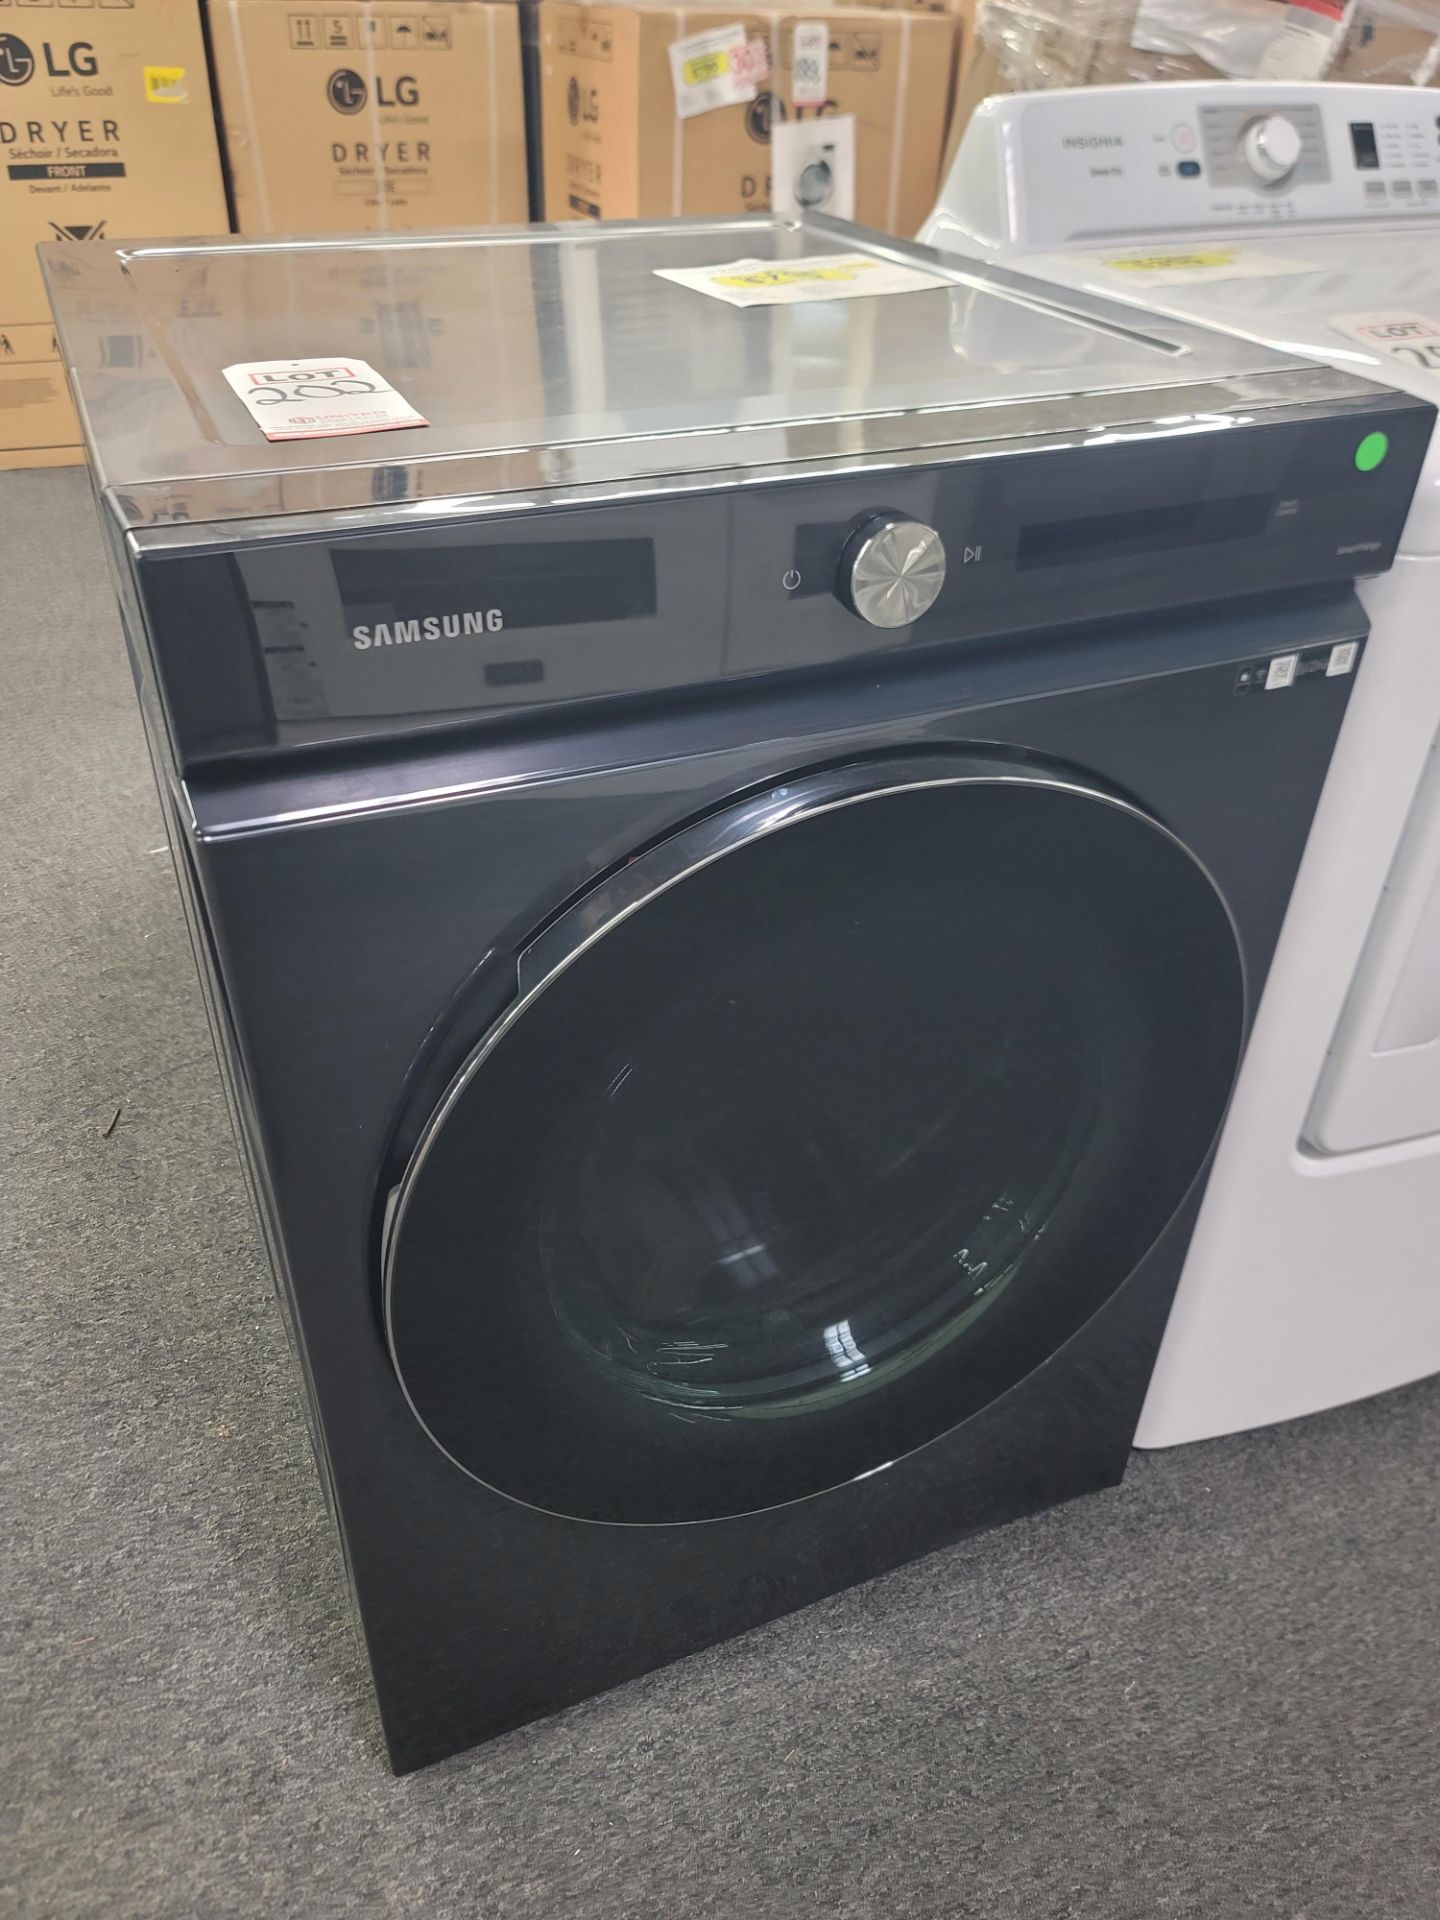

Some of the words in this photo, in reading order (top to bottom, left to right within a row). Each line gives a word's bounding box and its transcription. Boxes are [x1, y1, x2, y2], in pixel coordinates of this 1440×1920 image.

[43, 42, 98, 77] LG
[83, 86, 113, 96] Good
[376, 76, 420, 108] LG
[0, 120, 120, 144] DRYER
[64, 146, 119, 158] Secadora
[332, 142, 431, 162] DRYER
[46, 166, 86, 178] FRONT
[1368, 326, 1424, 338] LOT
[263, 369, 340, 382] LOT
[353, 609, 503, 650] SAMSUNG
